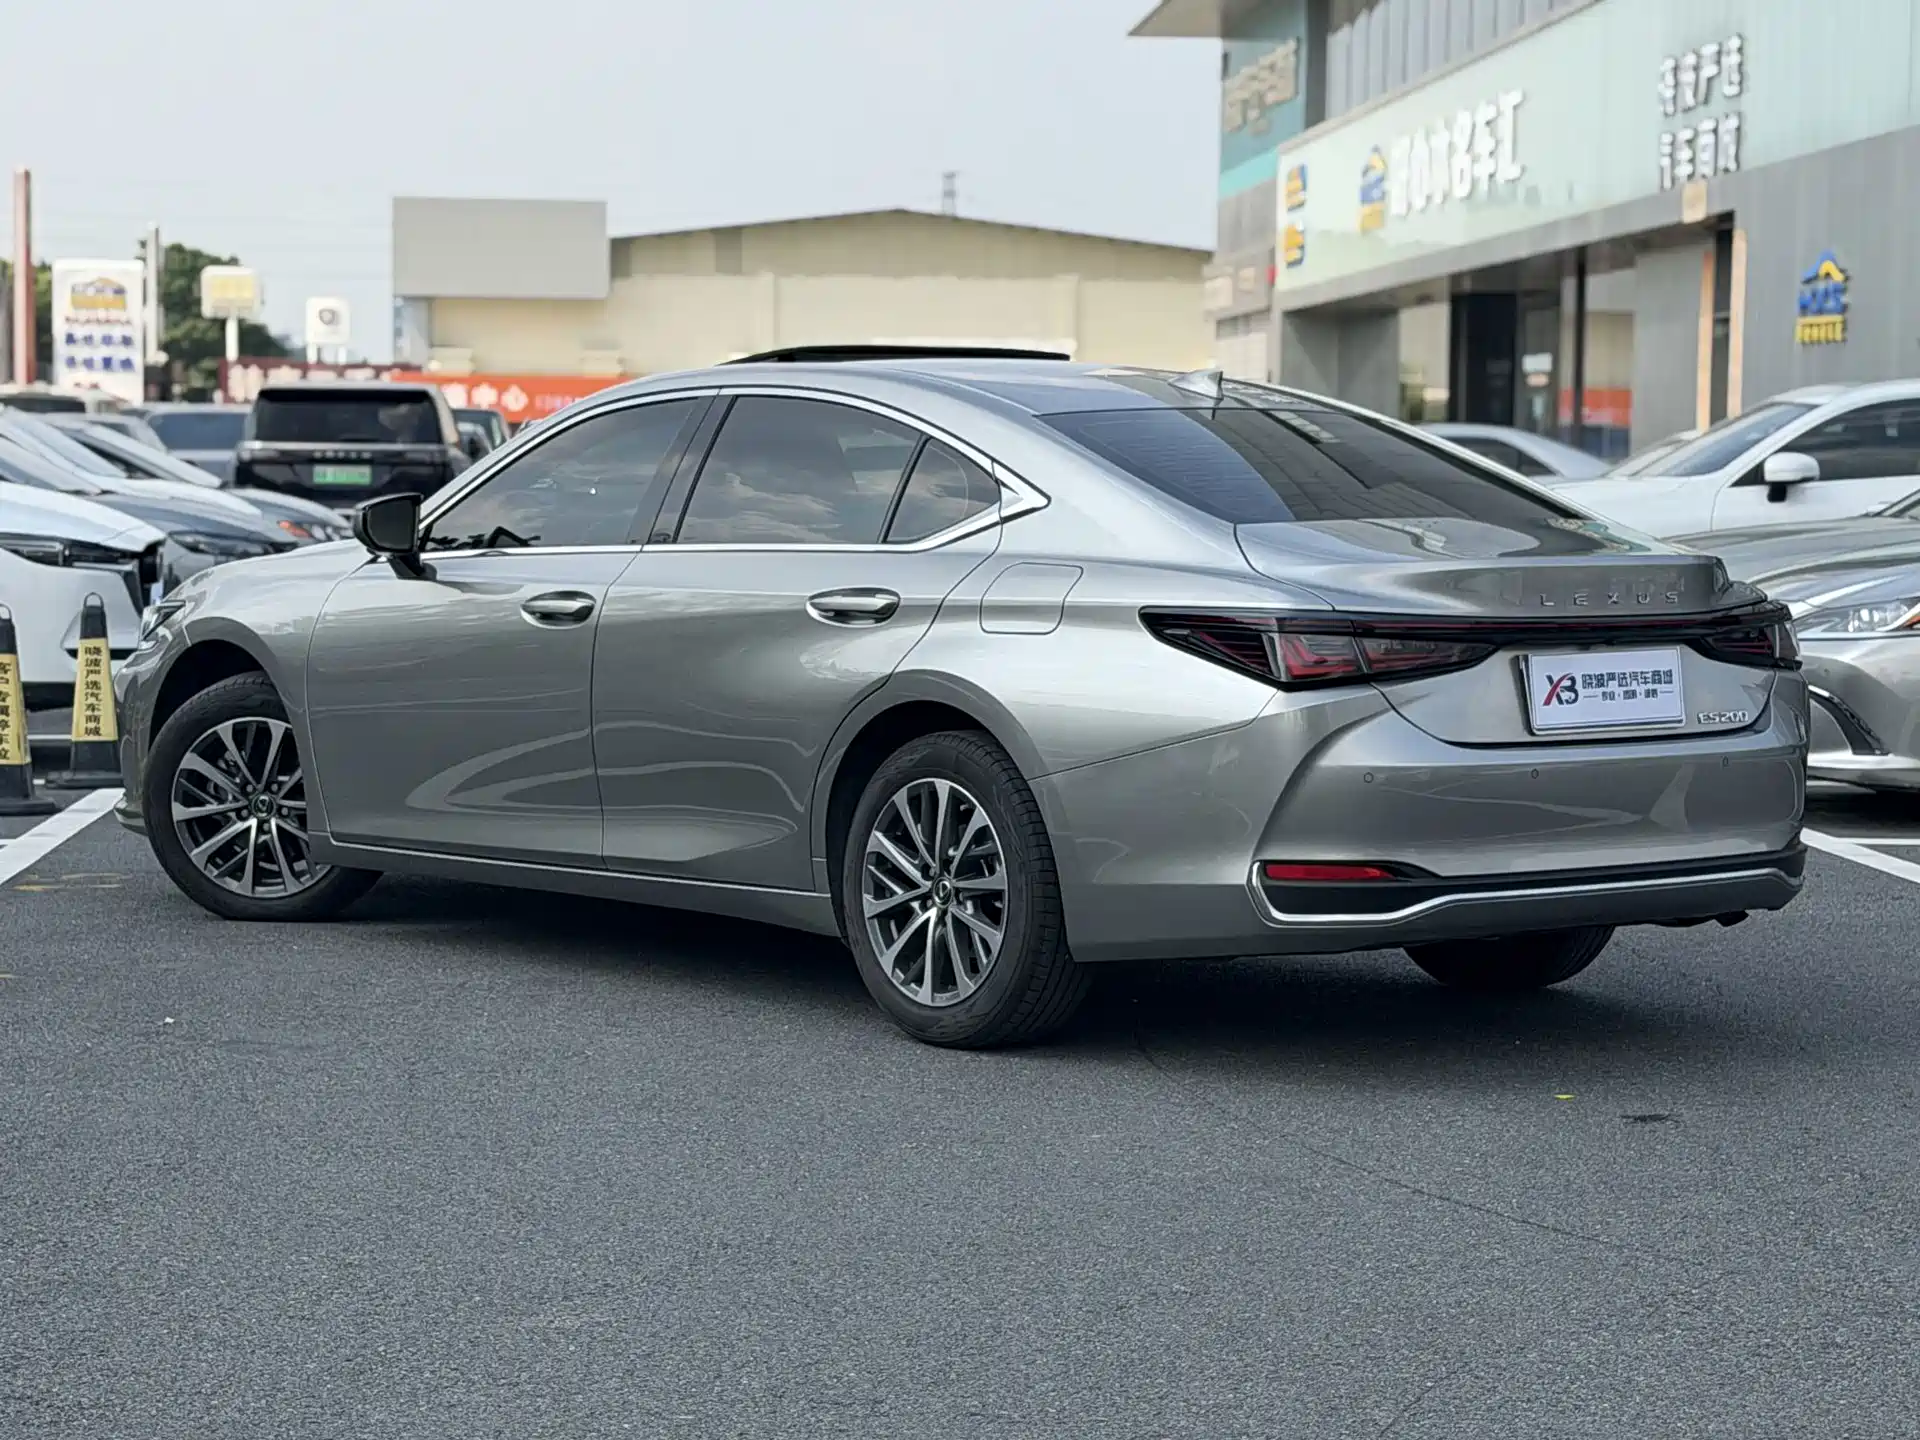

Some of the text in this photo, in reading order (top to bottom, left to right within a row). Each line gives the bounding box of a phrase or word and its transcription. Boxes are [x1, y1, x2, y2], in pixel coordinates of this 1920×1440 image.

[1540, 591, 1679, 606] LEXUS
[1581, 669, 1673, 689] 晓波严选汽车商城
[84, 645, 103, 737] 晓波严选汽车商城
[1697, 710, 1749, 724] ES200
